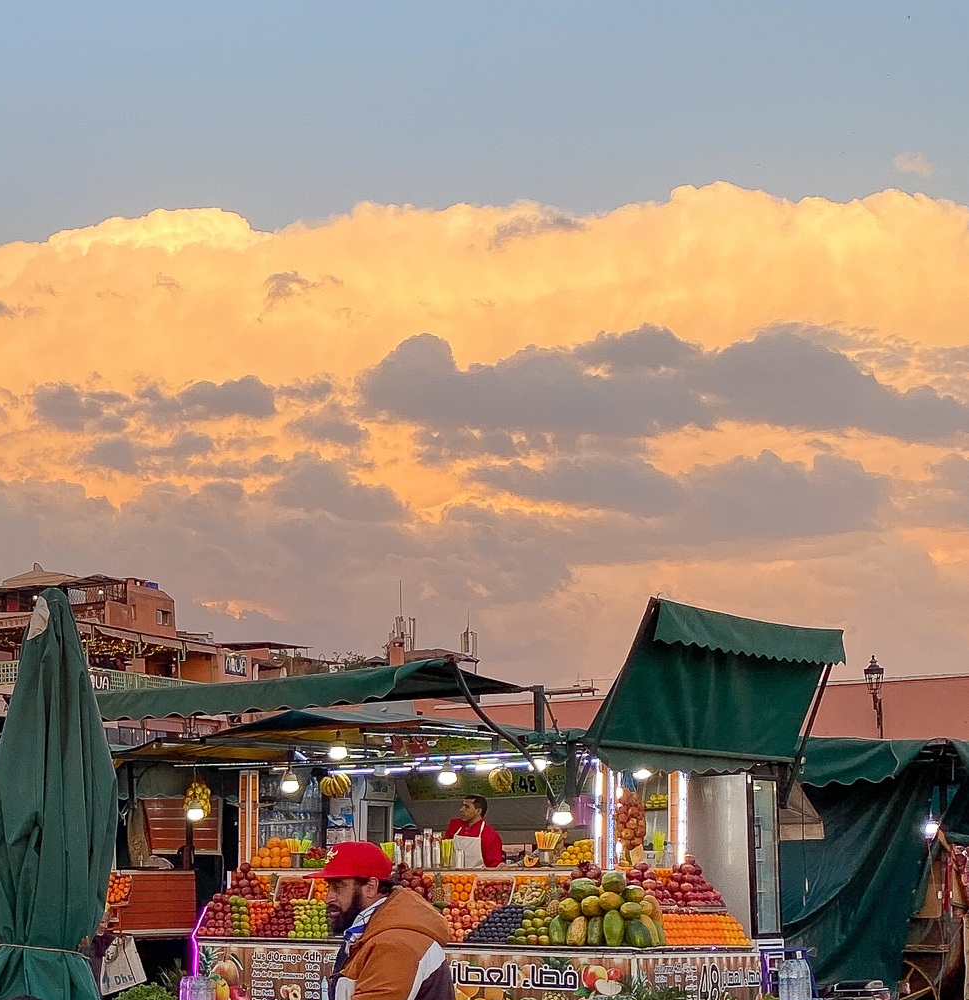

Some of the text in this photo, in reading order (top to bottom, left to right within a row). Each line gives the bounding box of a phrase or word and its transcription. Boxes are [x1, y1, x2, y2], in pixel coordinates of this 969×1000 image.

[251, 951, 267, 961] Jus
[267, 951, 301, 964] d'Orange
[302, 950, 322, 962] 4dh
[268, 962, 283, 970] Citron
[522, 962, 579, 989] فضاء
